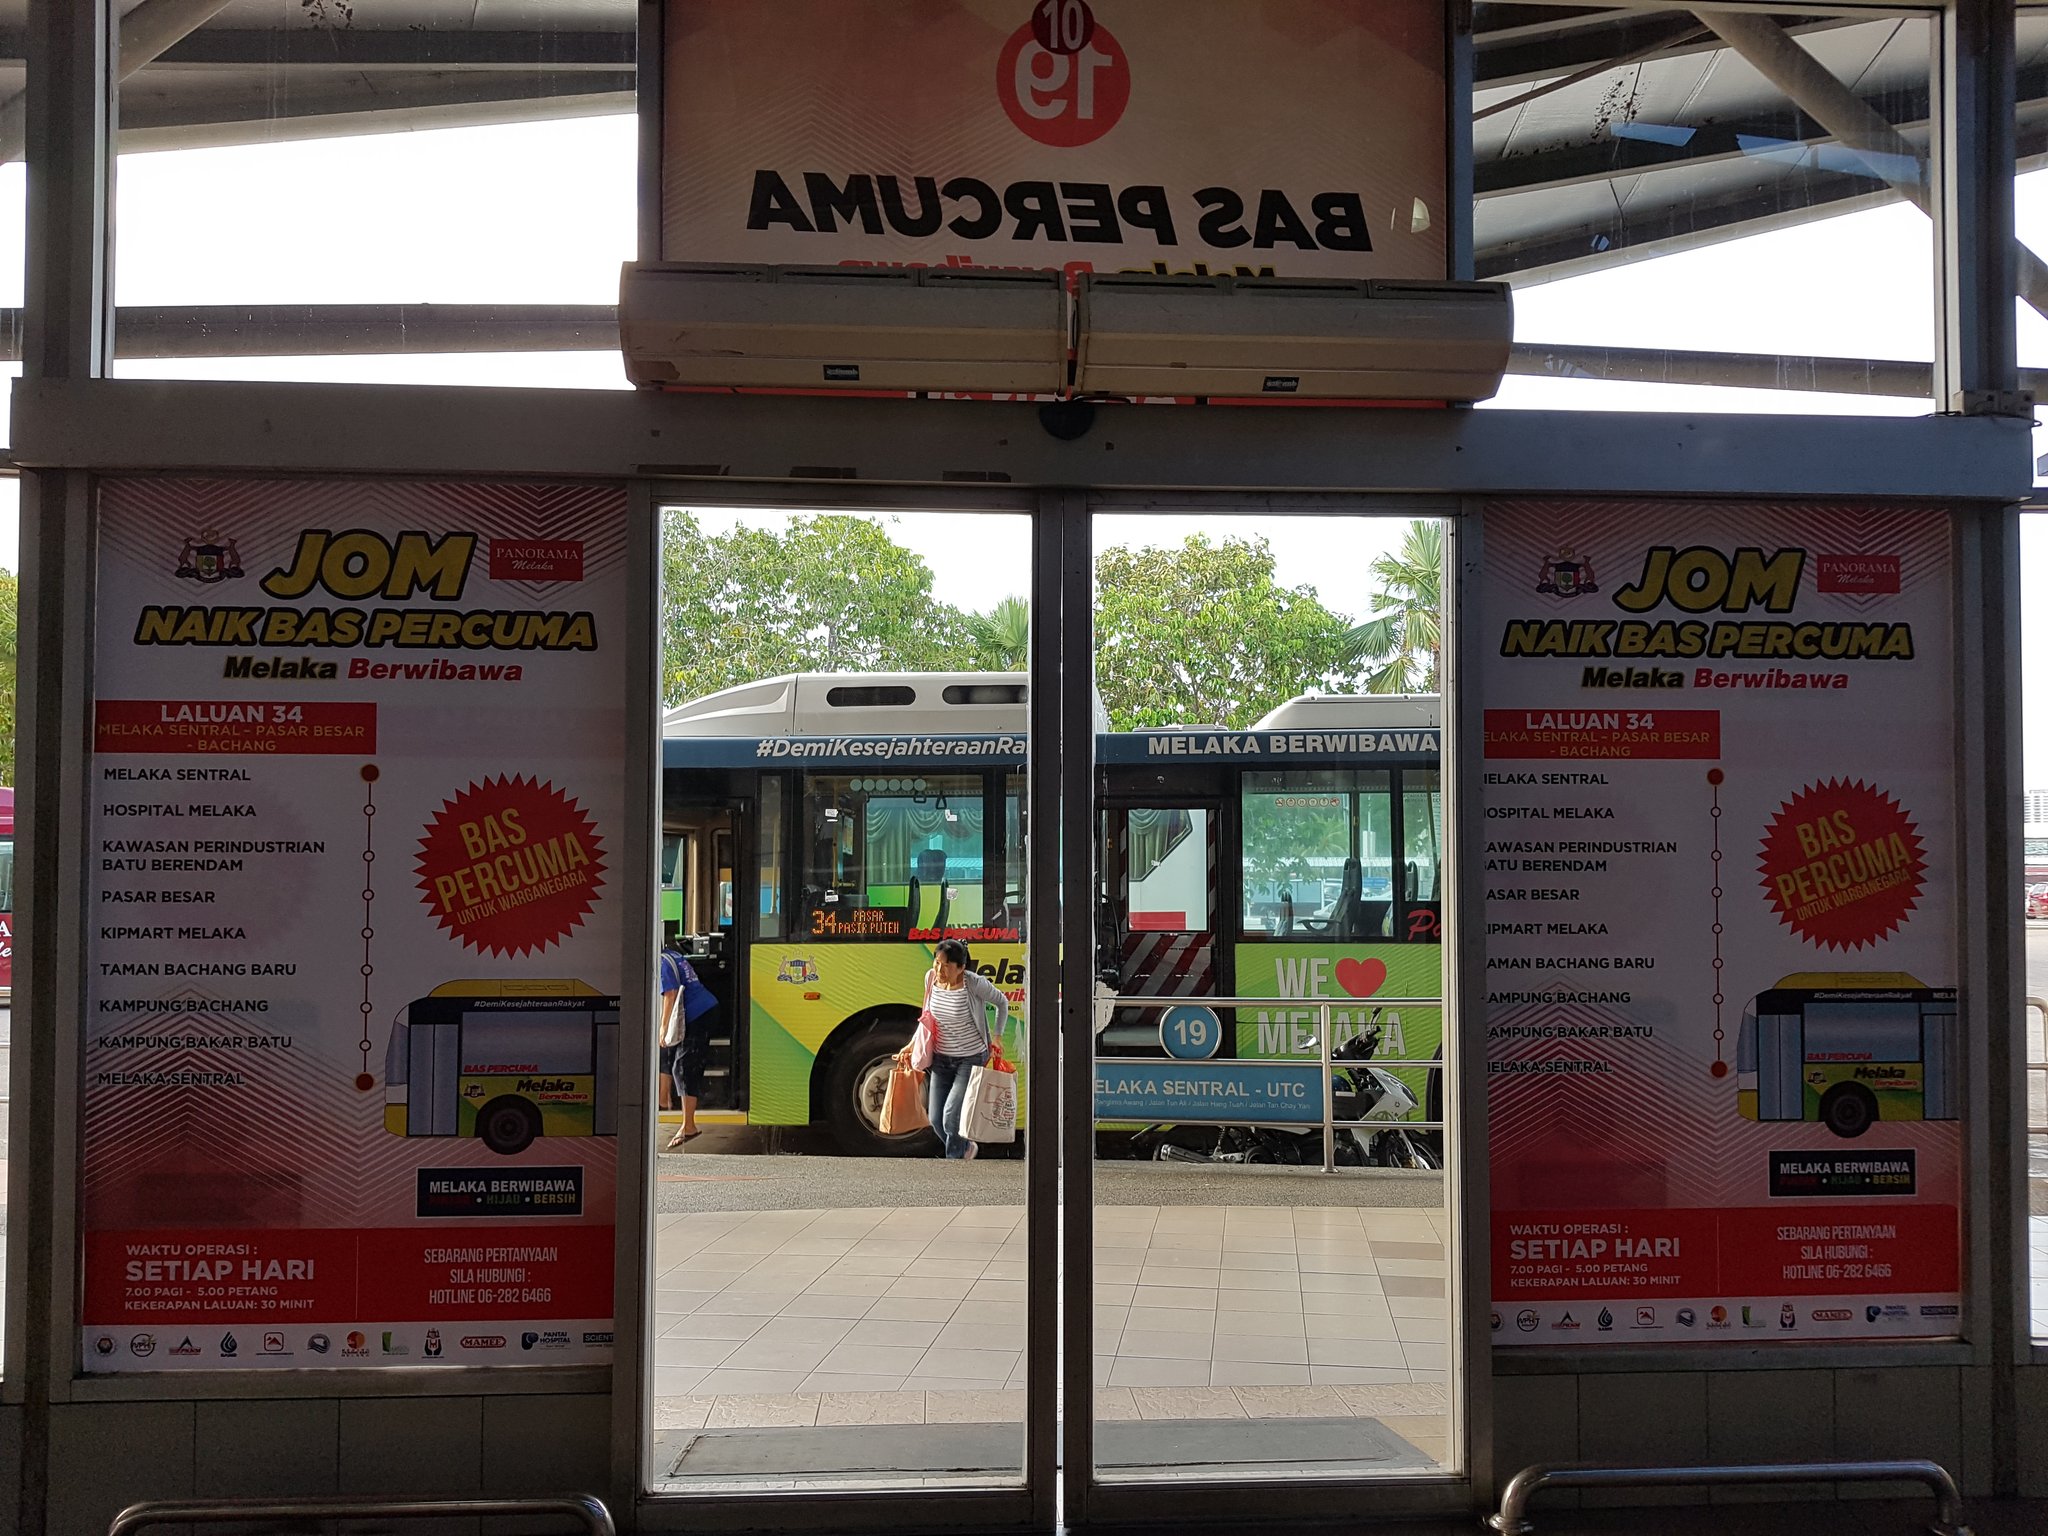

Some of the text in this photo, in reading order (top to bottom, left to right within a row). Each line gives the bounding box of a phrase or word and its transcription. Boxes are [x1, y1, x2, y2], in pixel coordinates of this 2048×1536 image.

[1042, 0, 1084, 50] 10
[496, 548, 578, 560] PANORAMA
[259, 529, 478, 601] JOM
[1822, 562, 1897, 574] PANORAMA
[1612, 545, 1806, 613] JOM
[133, 606, 598, 651] NAIK BAS PERCUMA
[1500, 620, 1915, 660] NAIK BAS PERCUMA
[223, 656, 524, 682] Melaka Berwibawa
[1581, 668, 1849, 690] Melaka Berwibawa
[160, 705, 303, 723] LALUAN 34
[1526, 713, 1654, 730] LALUAN 34
[98, 723, 365, 738] MELAKA SENTRAL PASAR BESAR
[1148, 733, 1438, 755] MELAKA BERWIBAWA
[1533, 731, 1710, 744] SENTRAL PASAR BESAR
[198, 740, 276, 752] BACHANG
[757, 737, 1027, 759] #DemiKesejahteraanRa
[1560, 745, 1631, 757] BACHANG
[103, 768, 251, 781] MELAKA SENTRAL
[1541, 773, 1609, 785] SENTRAL
[103, 804, 256, 817] HOSPITAL MELAKA
[1553, 807, 1615, 819] MELAKA
[459, 807, 527, 860] BAS
[1795, 809, 1857, 860] BAS
[102, 840, 326, 853] KAWASAN PERINDUSTRIAN
[1558, 841, 1677, 853] PERINDUSTRIAN
[102, 859, 243, 871] BATU BERENDAM
[1522, 860, 1607, 872] BERENDAM
[1775, 831, 1914, 910] PERCUMA
[433, 831, 591, 914] PERCUMA
[101, 891, 215, 903] PASAR BESAR
[456, 870, 588, 926] UNTUK WARGANEGARA
[1531, 889, 1580, 900] BESAR
[853, 910, 885, 922] PASAR
[1796, 900, 1833, 921] UNTUK
[812, 910, 837, 935] 34
[838, 922, 867, 934] PASIR
[1547, 923, 1609, 935] MELAKA
[101, 927, 246, 940] KIPMART MELAKA
[908, 927, 1019, 941] BAS PERCUMA
[100, 963, 296, 976] TAMAN BACHANG BARU
[1535, 957, 1655, 969] BACHANG BARU
[1275, 957, 1329, 999] WE
[1557, 992, 1631, 1004] BACHANG
[100, 1000, 269, 1013] KAMPUNG BACHANG
[1173, 1020, 1208, 1046] 19
[1558, 1026, 1653, 1038] BAKAR BATU
[98, 1036, 292, 1049] KAMPUNG BAKAR BATU
[1545, 1061, 1613, 1073] SENTRAL
[98, 1072, 246, 1085] MELAKA SENTRAL
[516, 1079, 575, 1093] Melaka
[1095, 1080, 1305, 1098] ELAKA SENTRAL UTC
[1780, 1161, 1910, 1174] MELAKA BERWIBAWA
[429, 1179, 576, 1193] MELAKA BERWIBAWA
[534, 1193, 576, 1205] BERSIH
[1510, 1223, 1621, 1235] WAKTU OPERASI
[1776, 1225, 1896, 1241] SEBARANG PERTANYAAN
[125, 1243, 250, 1256] WAKTU OPERASI
[423, 1246, 558, 1264] SEBARANG PERTANYAAN
[1510, 1237, 1680, 1260] SETIAP HARI
[1800, 1245, 1823, 1260] SILA
[125, 1259, 315, 1282] SETIAP HARI
[1510, 1263, 1648, 1275] 7.00 PAGI 5.00 PETANG
[1782, 1263, 1892, 1280] HOTLINE 06-282 6466
[449, 1268, 526, 1284] SILA HUBUNGI
[1510, 1275, 1681, 1287] KEKERAPAN LALUAN: 30 MINIT
[125, 1286, 279, 1297] 7.00 PAGI 5.00 PETANG
[429, 1287, 552, 1304] HOTLINE 06-282 6466
[124, 1298, 315, 1311] KEKERAPAN LALUAN: 30 MINIT
[464, 1338, 502, 1347] MAMEE
